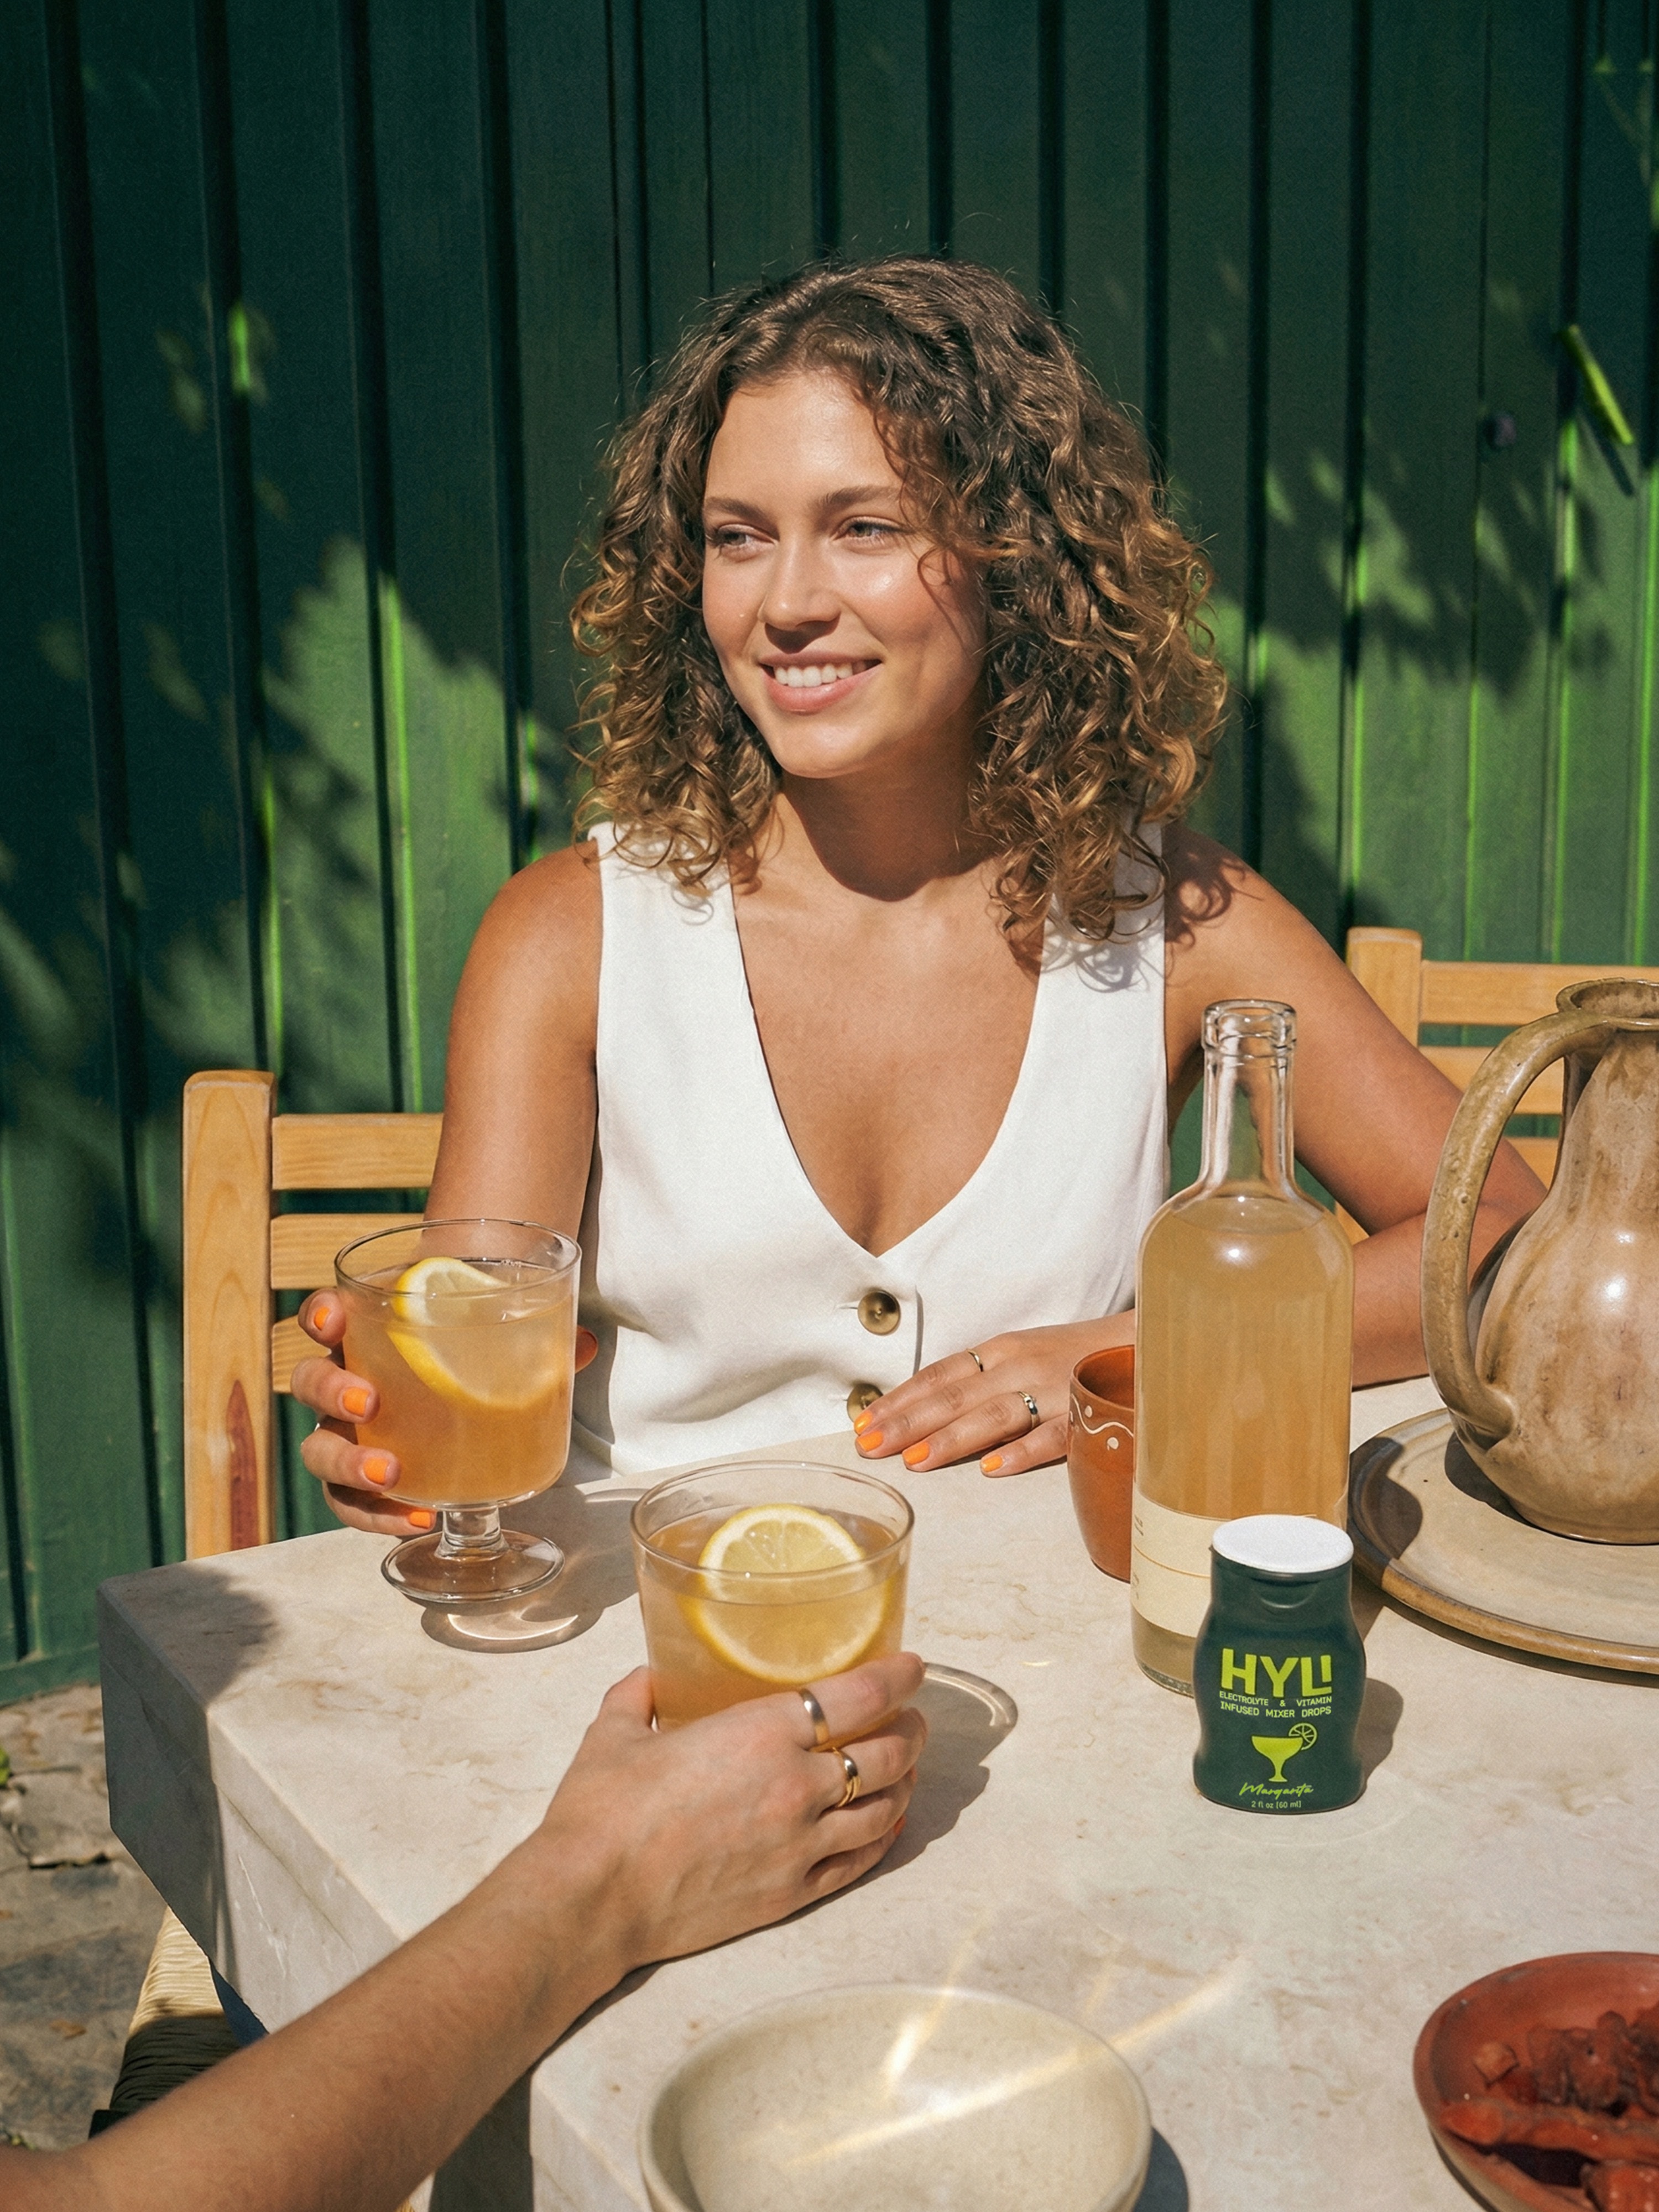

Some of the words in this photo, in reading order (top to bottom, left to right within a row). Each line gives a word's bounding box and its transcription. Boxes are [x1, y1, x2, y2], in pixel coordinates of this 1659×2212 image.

[1221, 1647, 1332, 1698] HYLI
[1219, 1691, 1269, 1706] ELECTROLYTE
[1296, 1696, 1332, 1707] VITAMIN
[1220, 1701, 1260, 1715] INFUSED
[1266, 1709, 1295, 1718] MIXER
[1302, 1706, 1332, 1718] DROPS
[1239, 1782, 1314, 1800] Margarita
